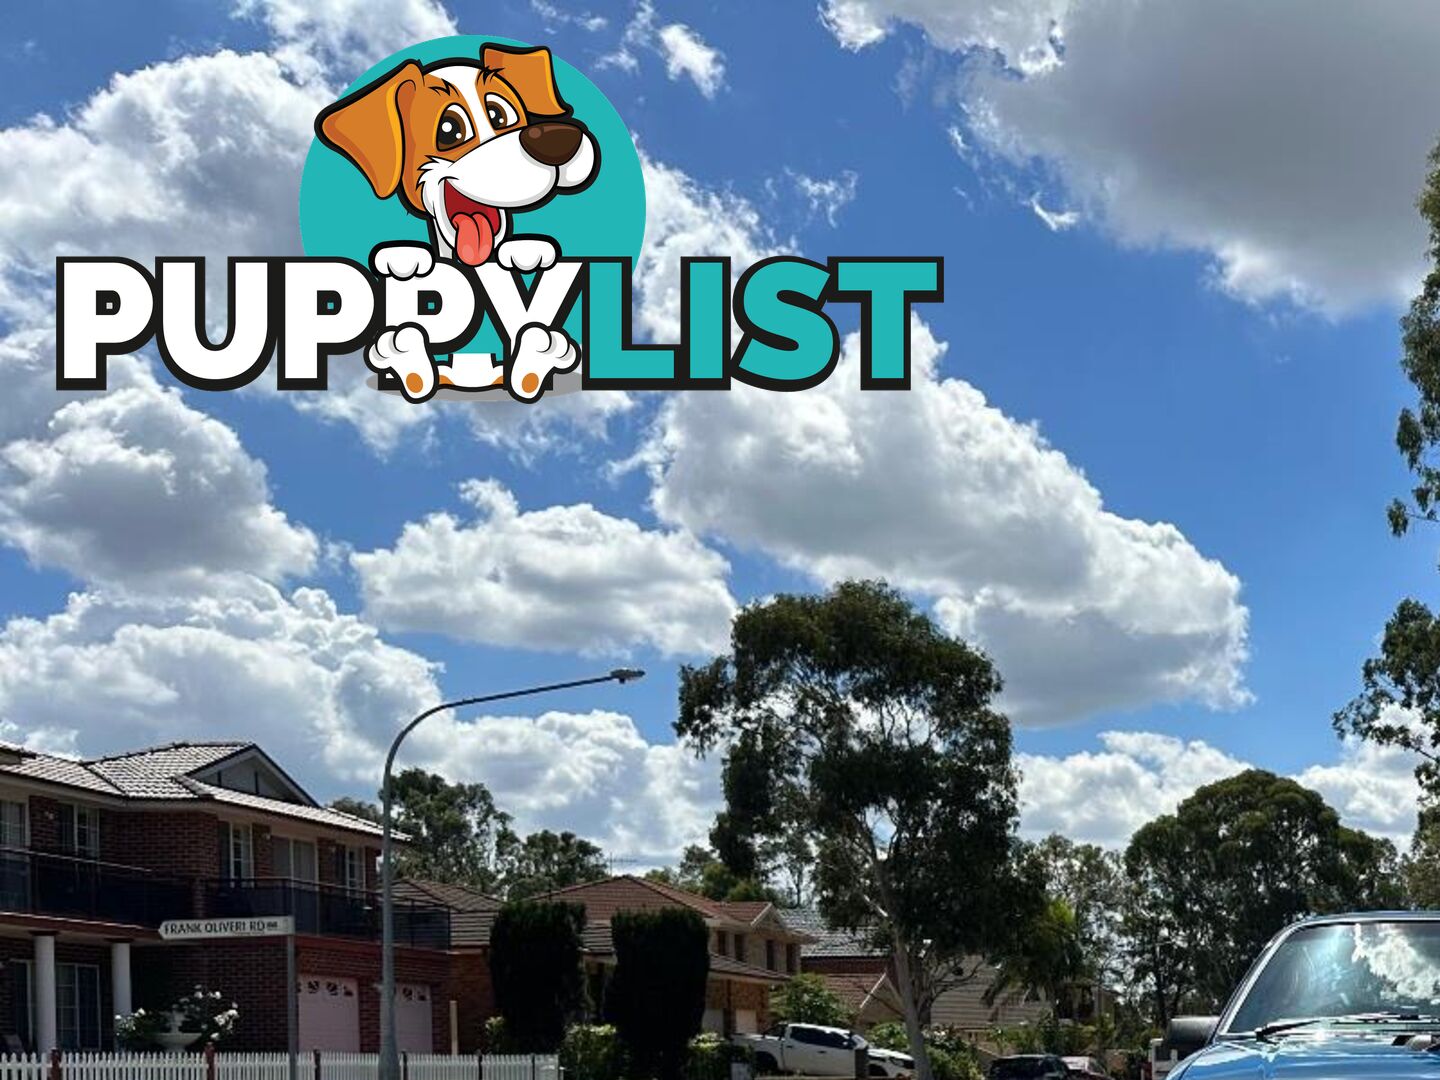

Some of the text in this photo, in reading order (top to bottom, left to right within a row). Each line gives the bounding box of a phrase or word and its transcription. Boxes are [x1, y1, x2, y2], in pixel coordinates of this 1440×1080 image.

[164, 922, 202, 935] FRANK
[204, 921, 246, 933] OLIVERI
[249, 920, 266, 932] RD
